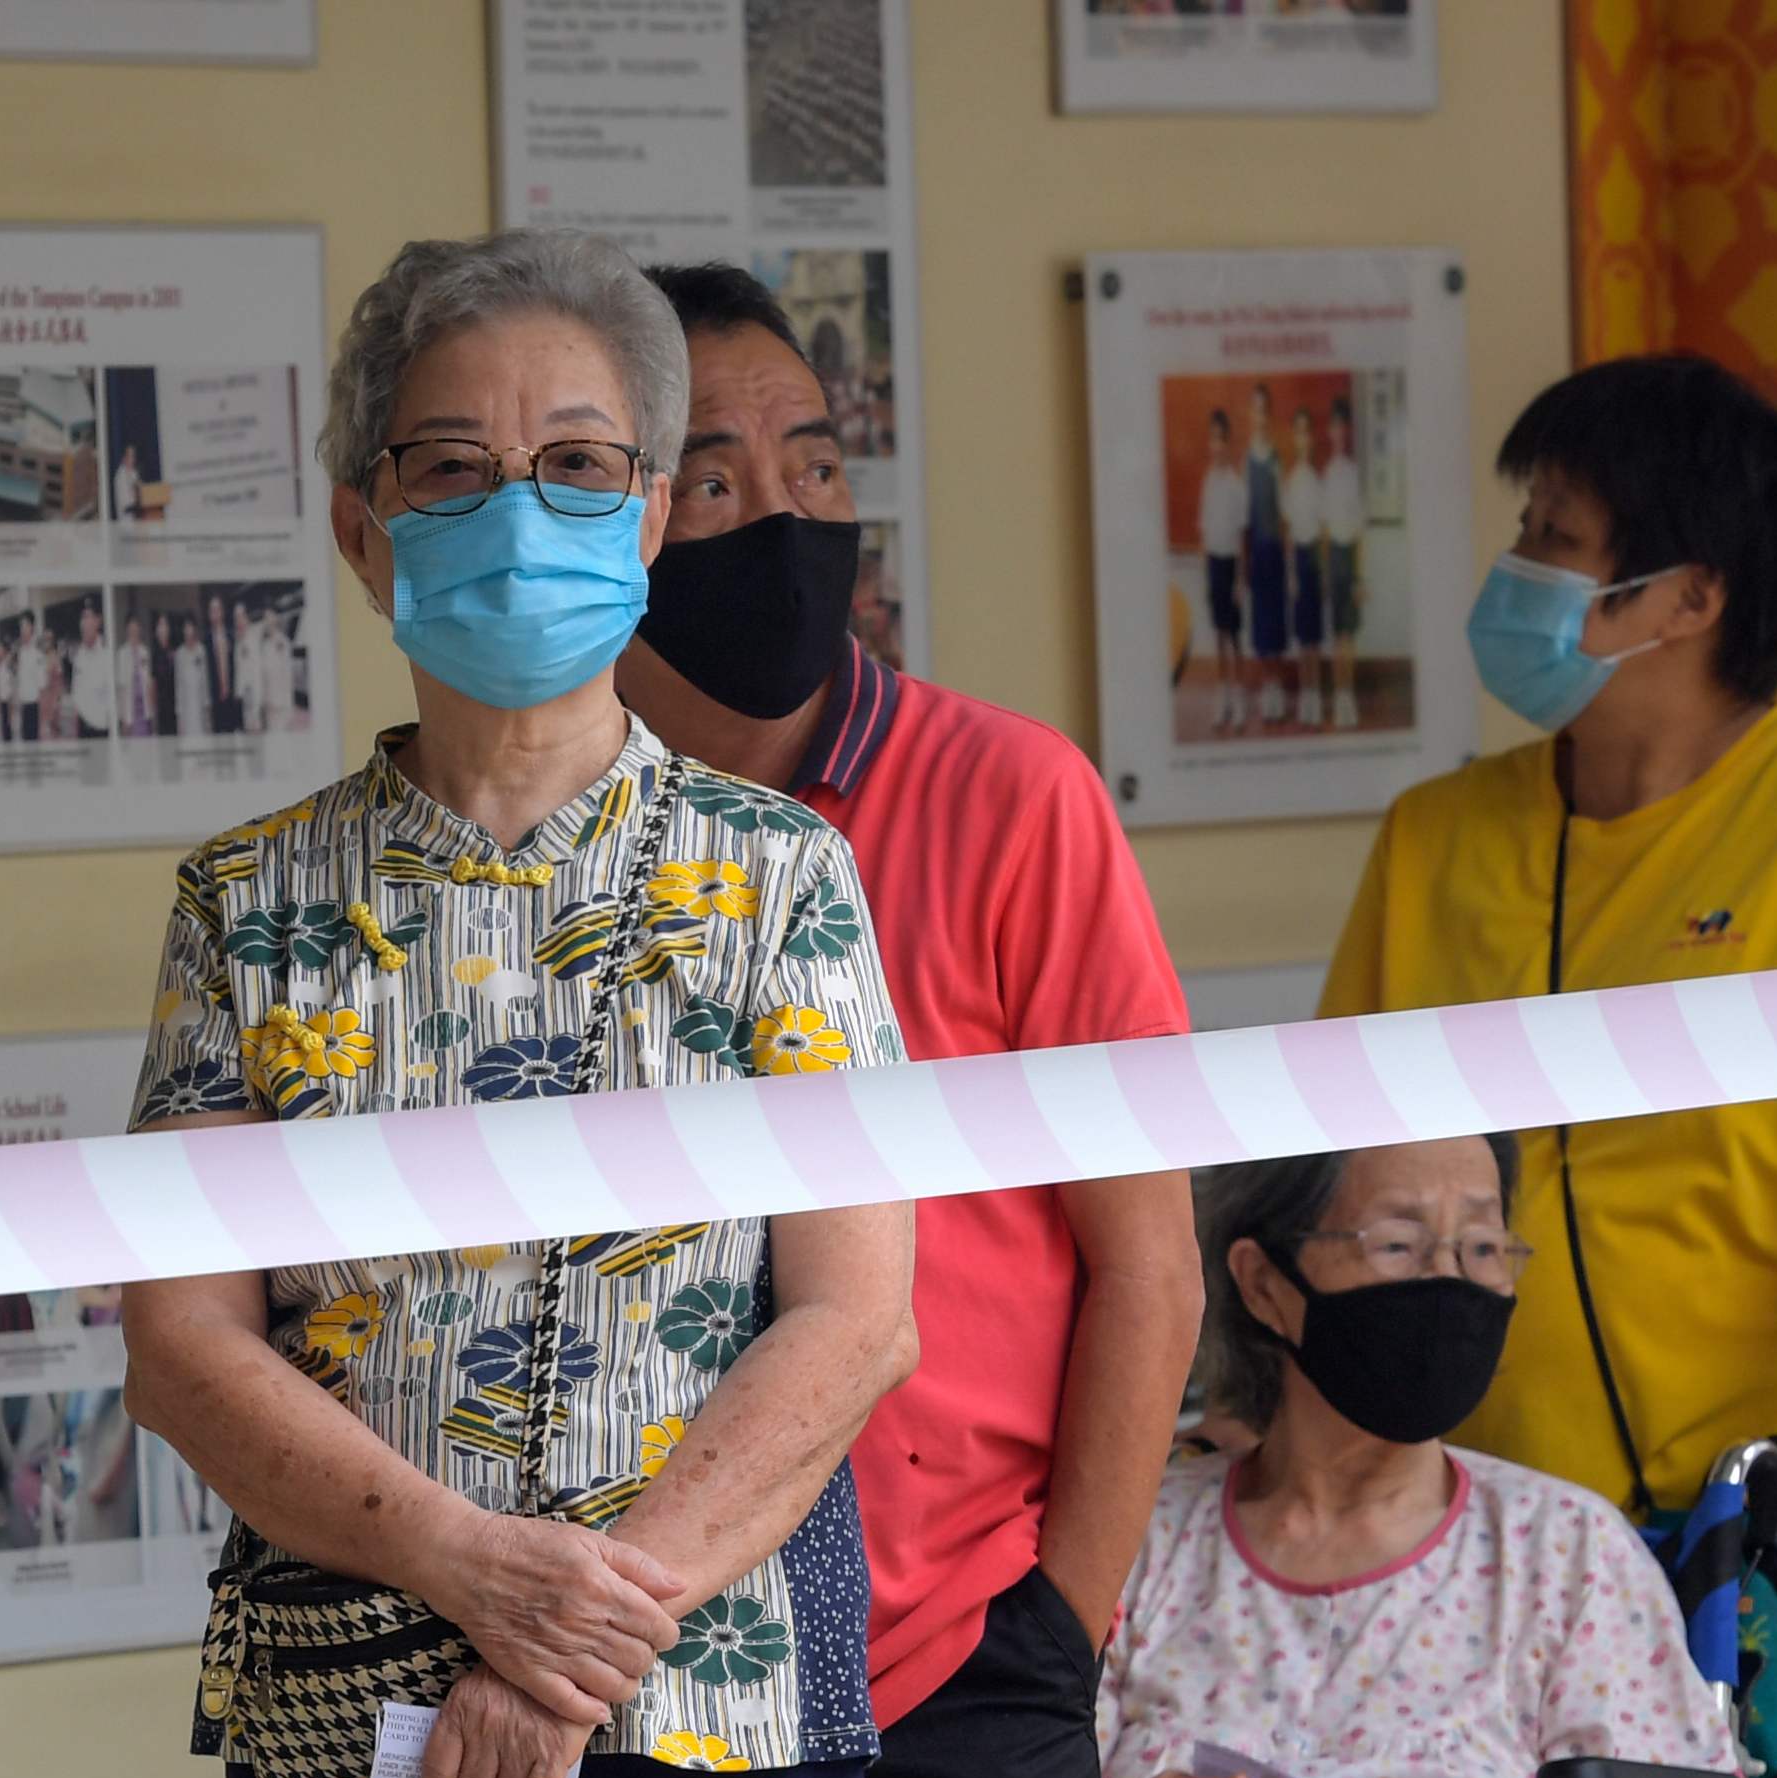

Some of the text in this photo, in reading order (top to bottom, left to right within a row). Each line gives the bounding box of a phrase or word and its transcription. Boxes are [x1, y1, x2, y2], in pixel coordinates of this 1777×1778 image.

[3, 1096, 41, 1119] School
[44, 1092, 68, 1116] Life
[387, 1712, 420, 1724] VOTING
[386, 1722, 405, 1731] THIS
[384, 1732, 423, 1743] CARD TO
